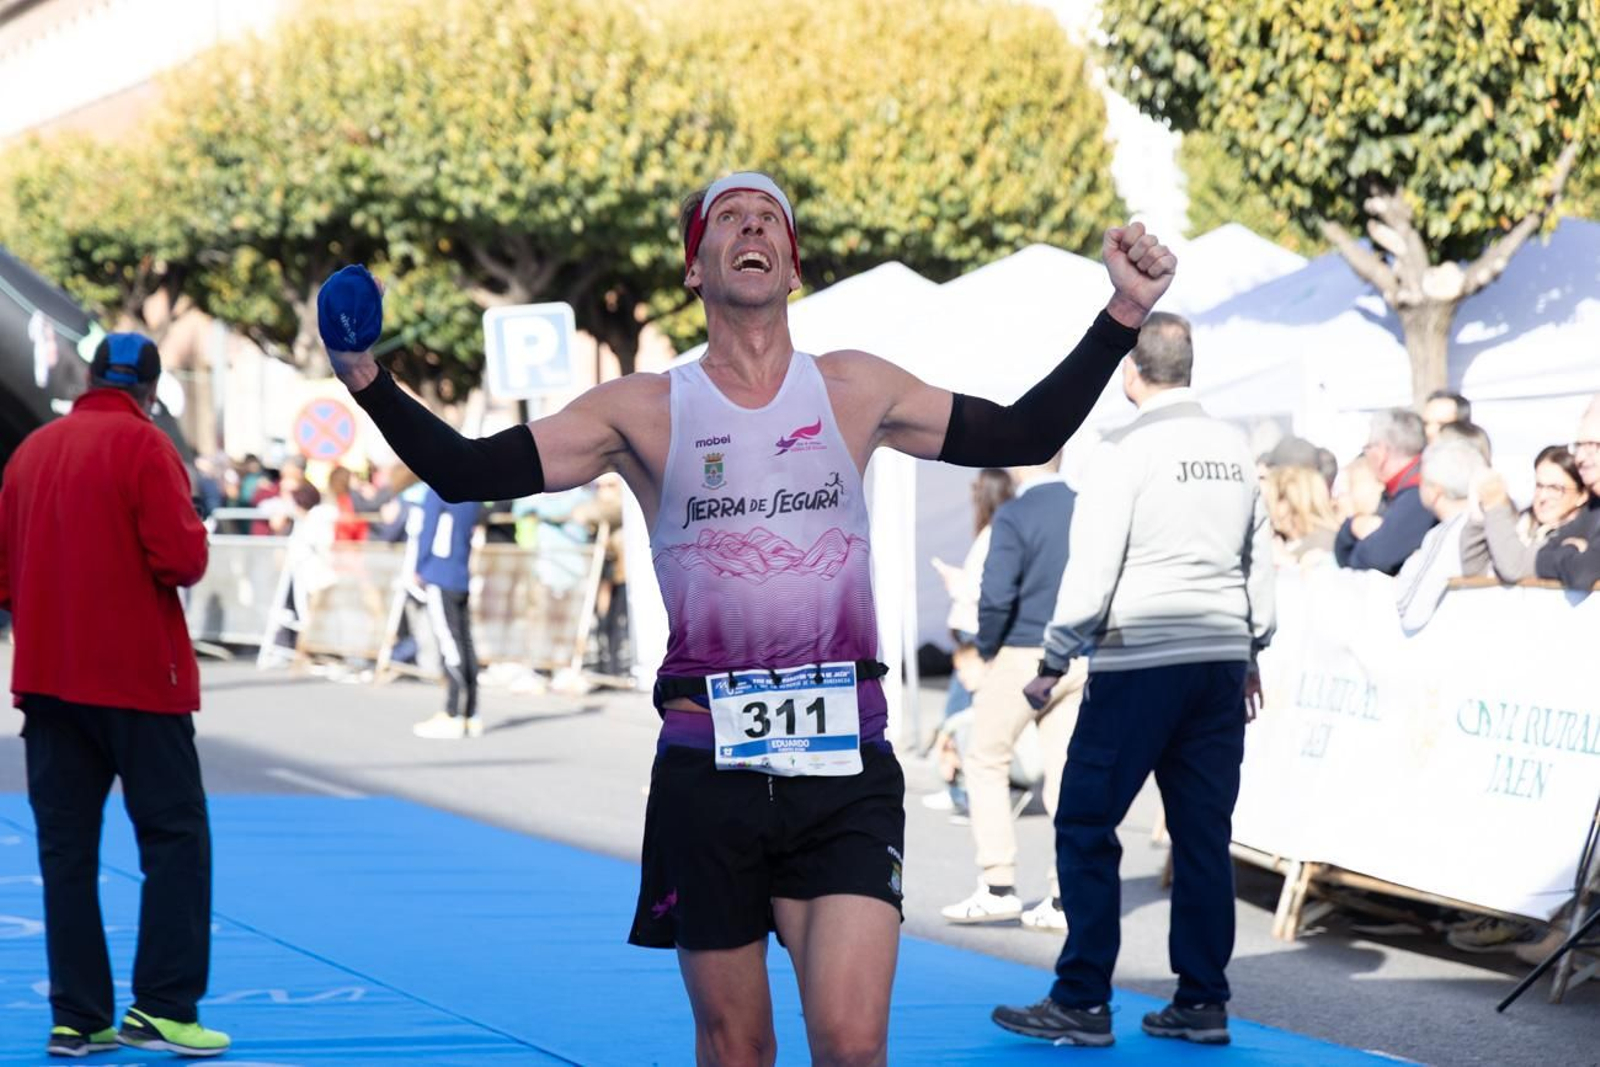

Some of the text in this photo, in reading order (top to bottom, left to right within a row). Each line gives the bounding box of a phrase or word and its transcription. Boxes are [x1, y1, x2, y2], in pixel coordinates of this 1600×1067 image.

[503, 316, 560, 389] P
[695, 434, 732, 448] mobel
[682, 488, 839, 529] SIERRA DE SEGURA
[742, 696, 827, 739] 311
[771, 738, 810, 749] EDUARDO
